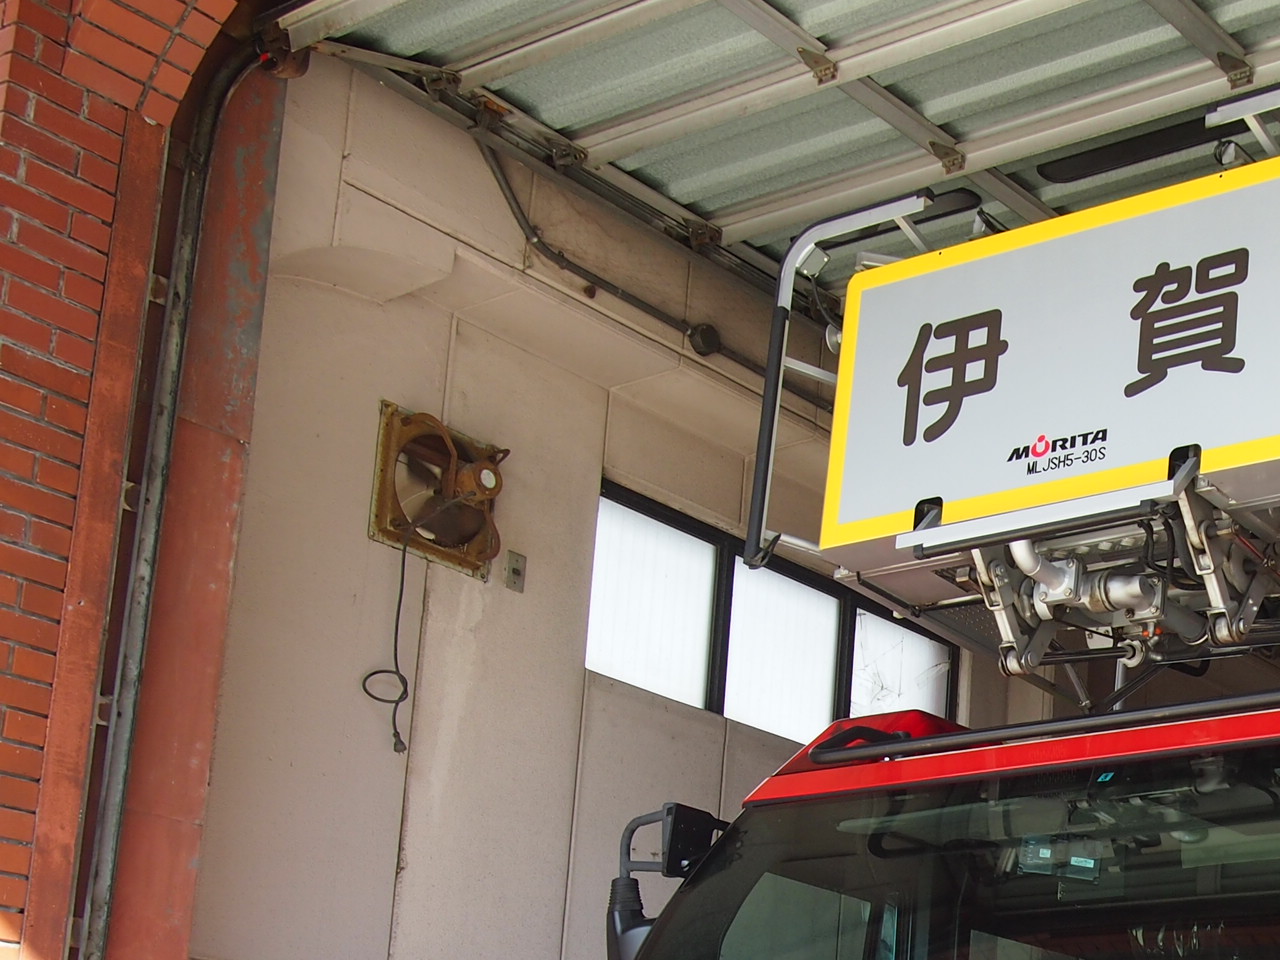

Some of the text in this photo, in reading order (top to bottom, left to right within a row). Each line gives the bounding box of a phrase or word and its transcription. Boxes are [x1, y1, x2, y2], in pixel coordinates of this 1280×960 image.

[897, 246, 1250, 446] 伊賀
[1007, 428, 1108, 462] MORITA
[1026, 446, 1106, 475] MLJSH5-30S
